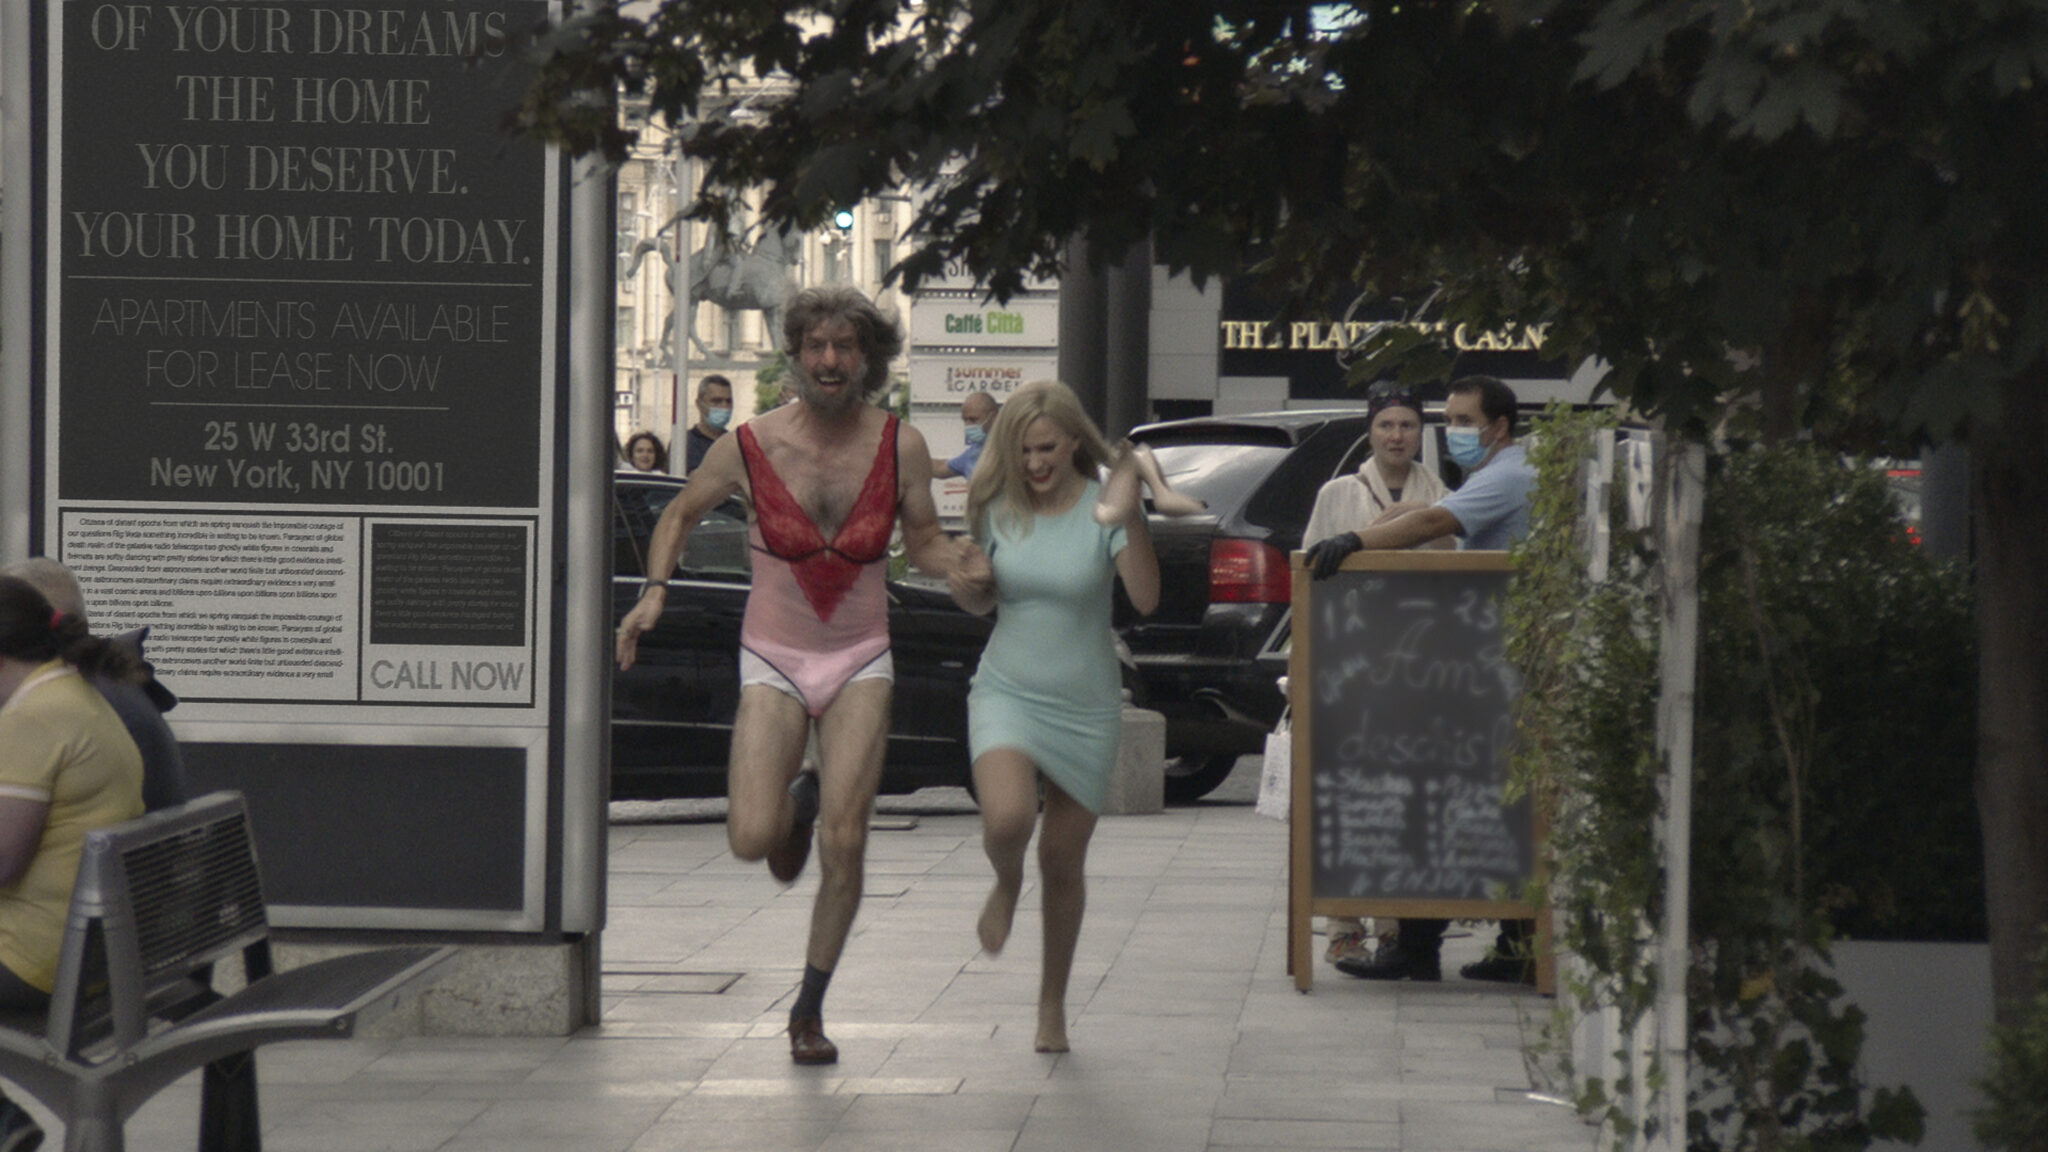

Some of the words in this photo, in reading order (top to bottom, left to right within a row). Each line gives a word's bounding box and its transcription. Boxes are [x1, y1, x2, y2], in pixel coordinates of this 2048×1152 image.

[90, 4, 152, 52] OF
[164, 5, 295, 54] YOUR
[309, 8, 507, 58] DREAMS
[175, 74, 276, 123] THE
[291, 76, 431, 126] HOME
[134, 142, 230, 191] YOU
[244, 144, 469, 195] DESERVE.
[70, 210, 200, 260] YOUR
[215, 213, 354, 262] HOME
[368, 216, 531, 265] TODAY.
[91, 298, 316, 340] APARTMENTS
[330, 302, 509, 343] AVAILABLE
[945, 313, 983, 334] Caffé
[986, 311, 1024, 334] Città
[146, 349, 219, 389] FOR
[234, 350, 333, 391] LEASE
[347, 352, 442, 393] NOW
[203, 420, 239, 451] 25
[247, 420, 277, 452] W
[284, 421, 352, 453] 33rd
[359, 422, 394, 454] St.
[150, 456, 219, 487] New
[226, 457, 301, 493] York,
[311, 459, 354, 489] NY
[364, 459, 444, 491] 10001
[370, 660, 443, 690] CALL
[450, 661, 524, 692] NOW
